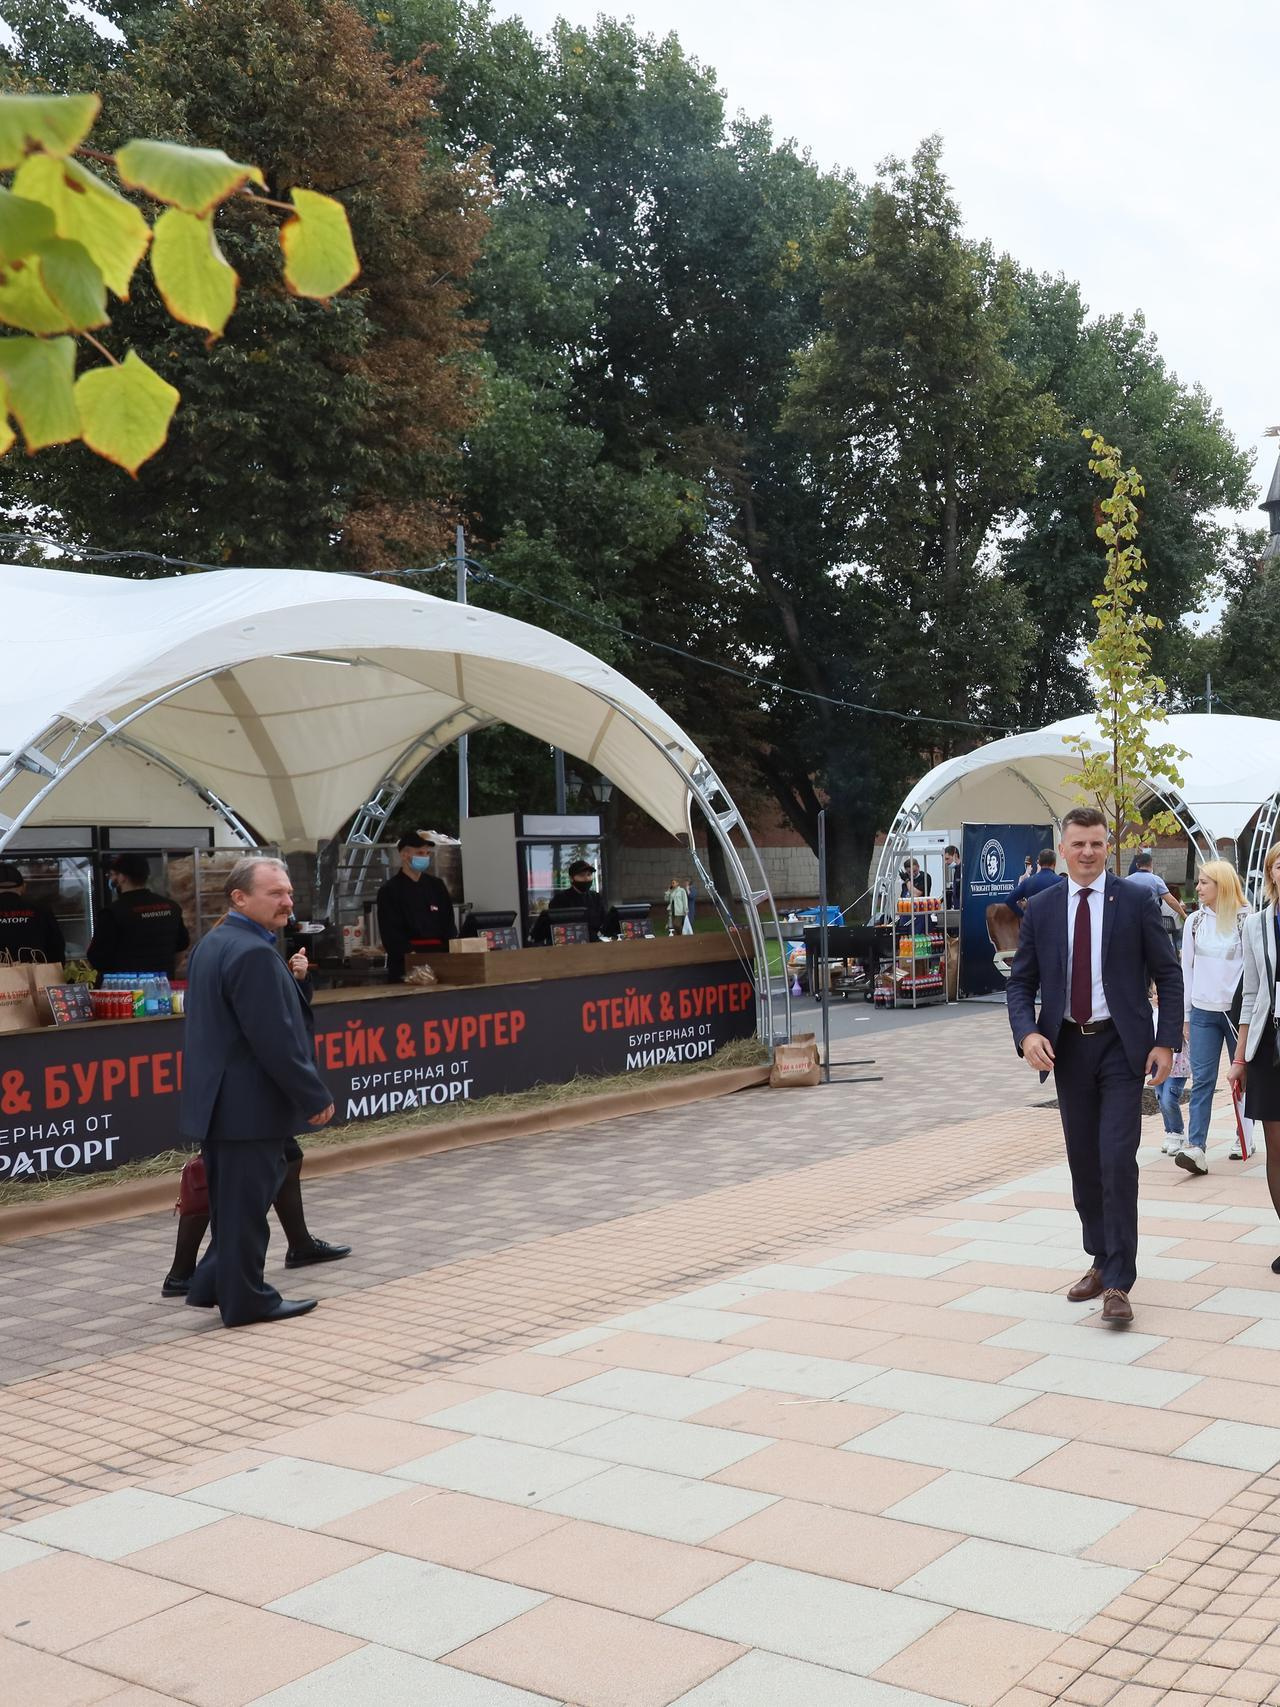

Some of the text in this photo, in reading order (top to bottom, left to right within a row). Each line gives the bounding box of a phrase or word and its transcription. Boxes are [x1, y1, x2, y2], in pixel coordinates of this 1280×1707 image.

[582, 982, 752, 1033] СТЕЙК & БУРГЕР
[396, 1023, 416, 1059] &
[424, 1010, 526, 1057] БУРГЕР
[629, 1023, 712, 1047] БУРГЕРНАЯ ОТ
[626, 1039, 715, 1070] МИРАТОРГ
[1, 1069, 32, 1115] &
[351, 1061, 469, 1090] БУРГЕРНАЯ ОТ
[346, 1079, 474, 1120] МИРАТОРГ
[86, 1113, 113, 1132] ОТ
